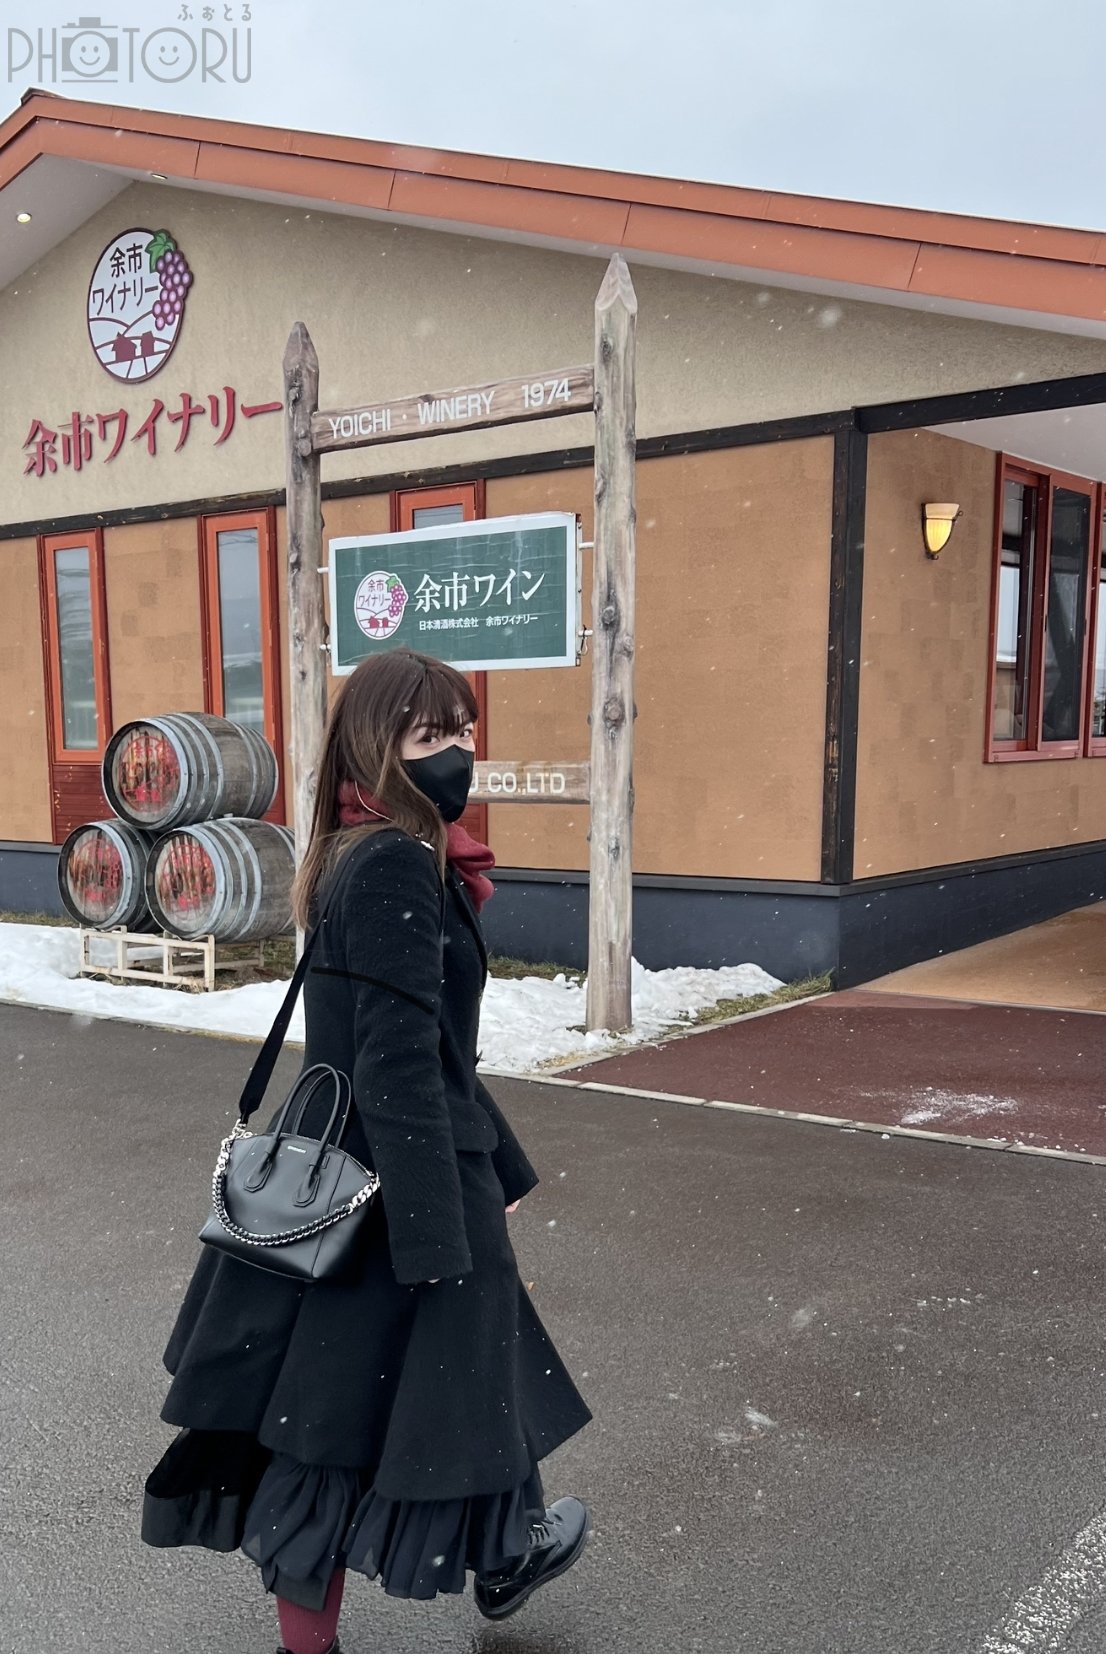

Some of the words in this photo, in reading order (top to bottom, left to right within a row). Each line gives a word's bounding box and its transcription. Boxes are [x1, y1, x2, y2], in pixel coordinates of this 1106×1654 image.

[109, 243, 143, 278] 余市
[92, 277, 159, 316] ワイナリー
[329, 409, 391, 440] YOICHI
[417, 391, 495, 425] WINERY
[521, 378, 571, 408] 1974
[22, 386, 283, 477] 余市ワイナリー
[359, 593, 391, 607] ワイナリー
[368, 579, 384, 592] 余市
[413, 568, 545, 613] 余市ワイン
[486, 614, 538, 627] 余市ワイナリー
